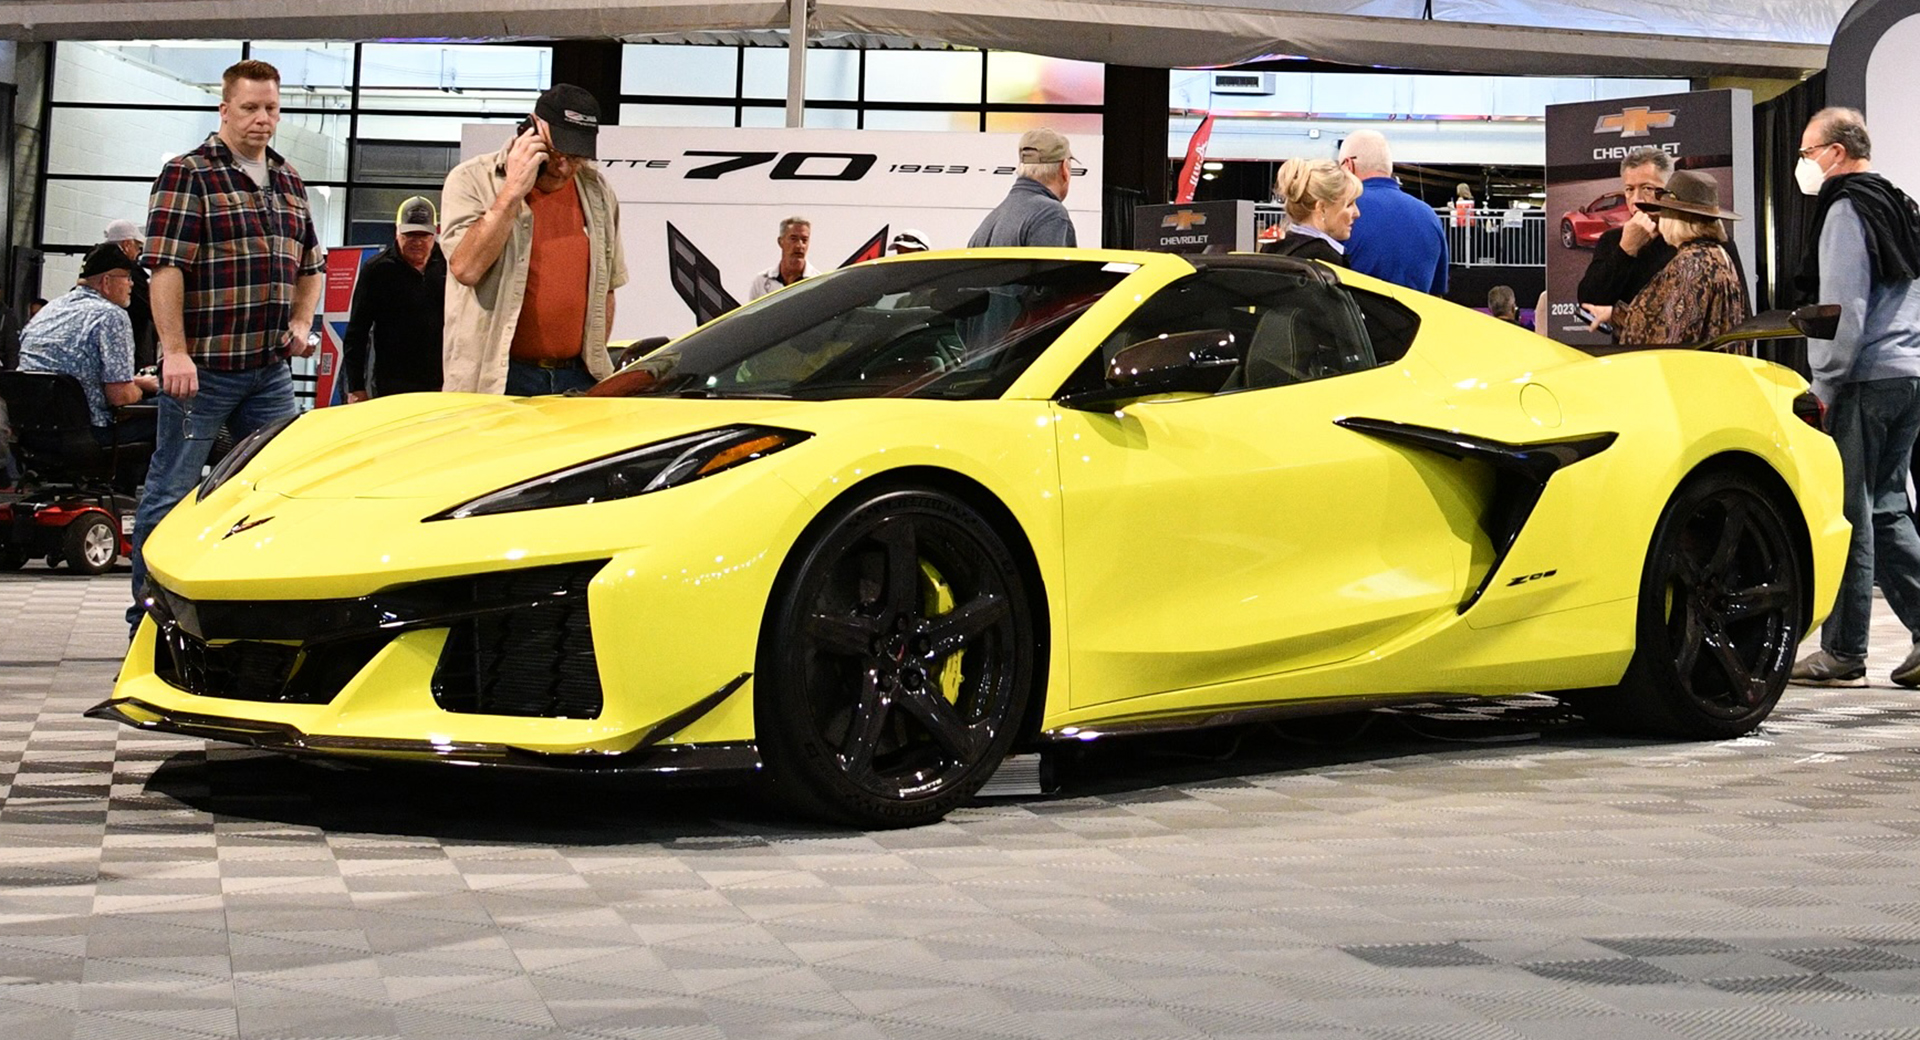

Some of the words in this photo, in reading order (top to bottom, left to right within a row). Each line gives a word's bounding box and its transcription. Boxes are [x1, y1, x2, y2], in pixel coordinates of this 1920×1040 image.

[1593, 142, 1681, 160] CHEVET
[682, 150, 878, 181] 70
[889, 164, 970, 174] 1953
[992, 166, 1088, 177] 23
[1160, 235, 1208, 246] CHEVROLET
[1551, 303, 1575, 316] 2023
